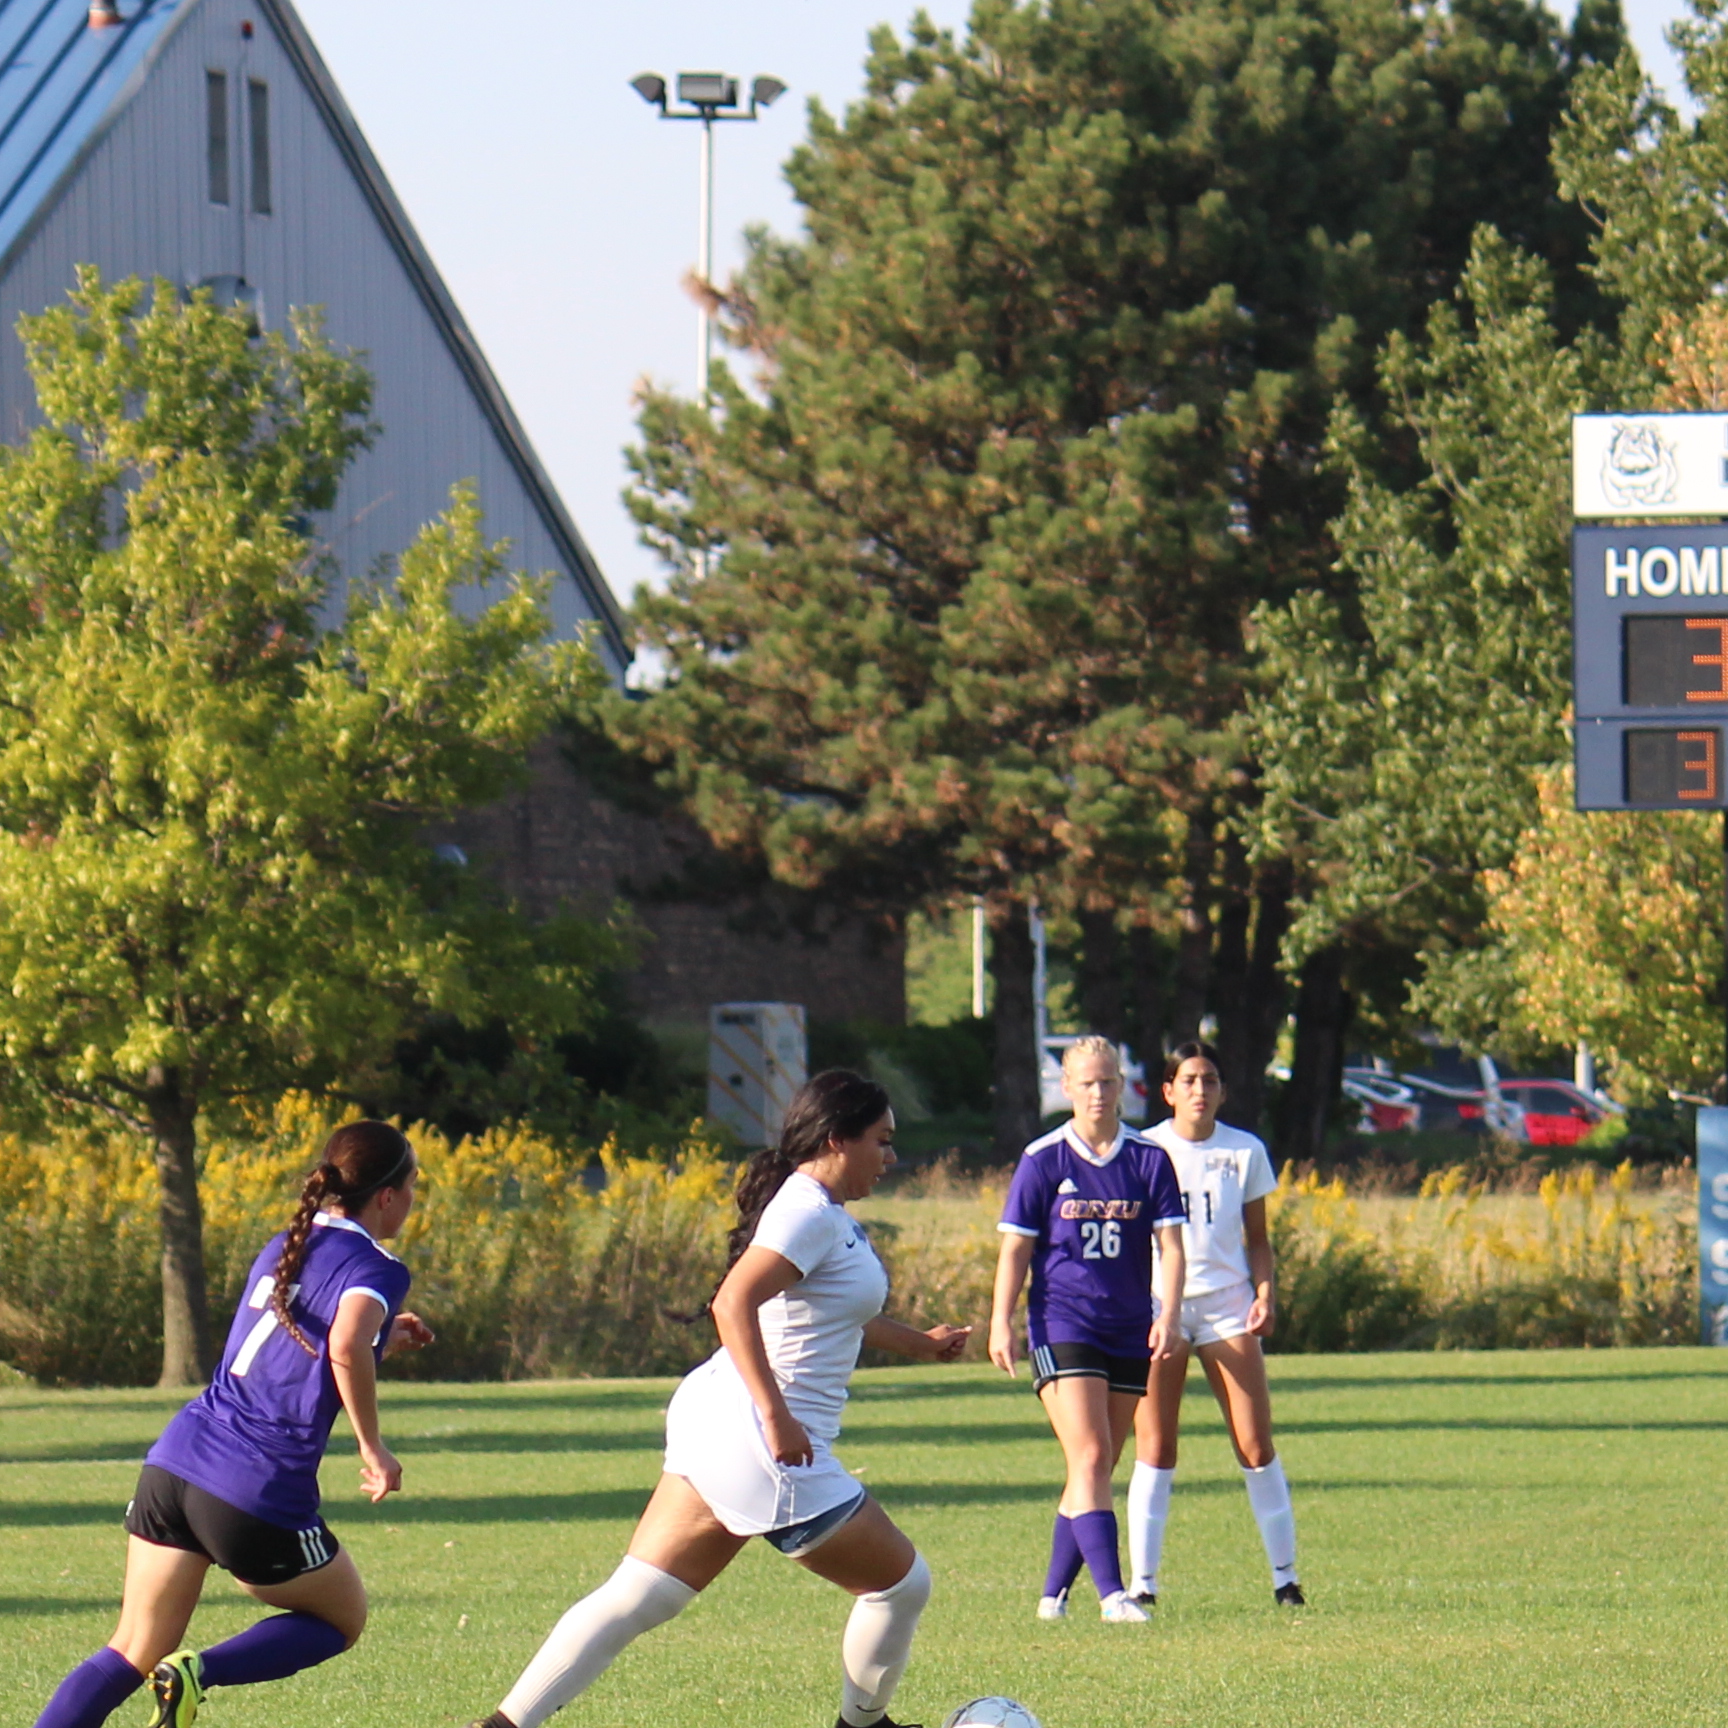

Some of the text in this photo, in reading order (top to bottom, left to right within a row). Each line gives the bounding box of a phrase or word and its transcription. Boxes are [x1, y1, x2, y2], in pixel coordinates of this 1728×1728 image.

[1677, 731, 1716, 800] 3
[1181, 1190, 1213, 1225] 11
[1081, 1221, 1122, 1260] 26
[229, 1274, 301, 1378] 7
